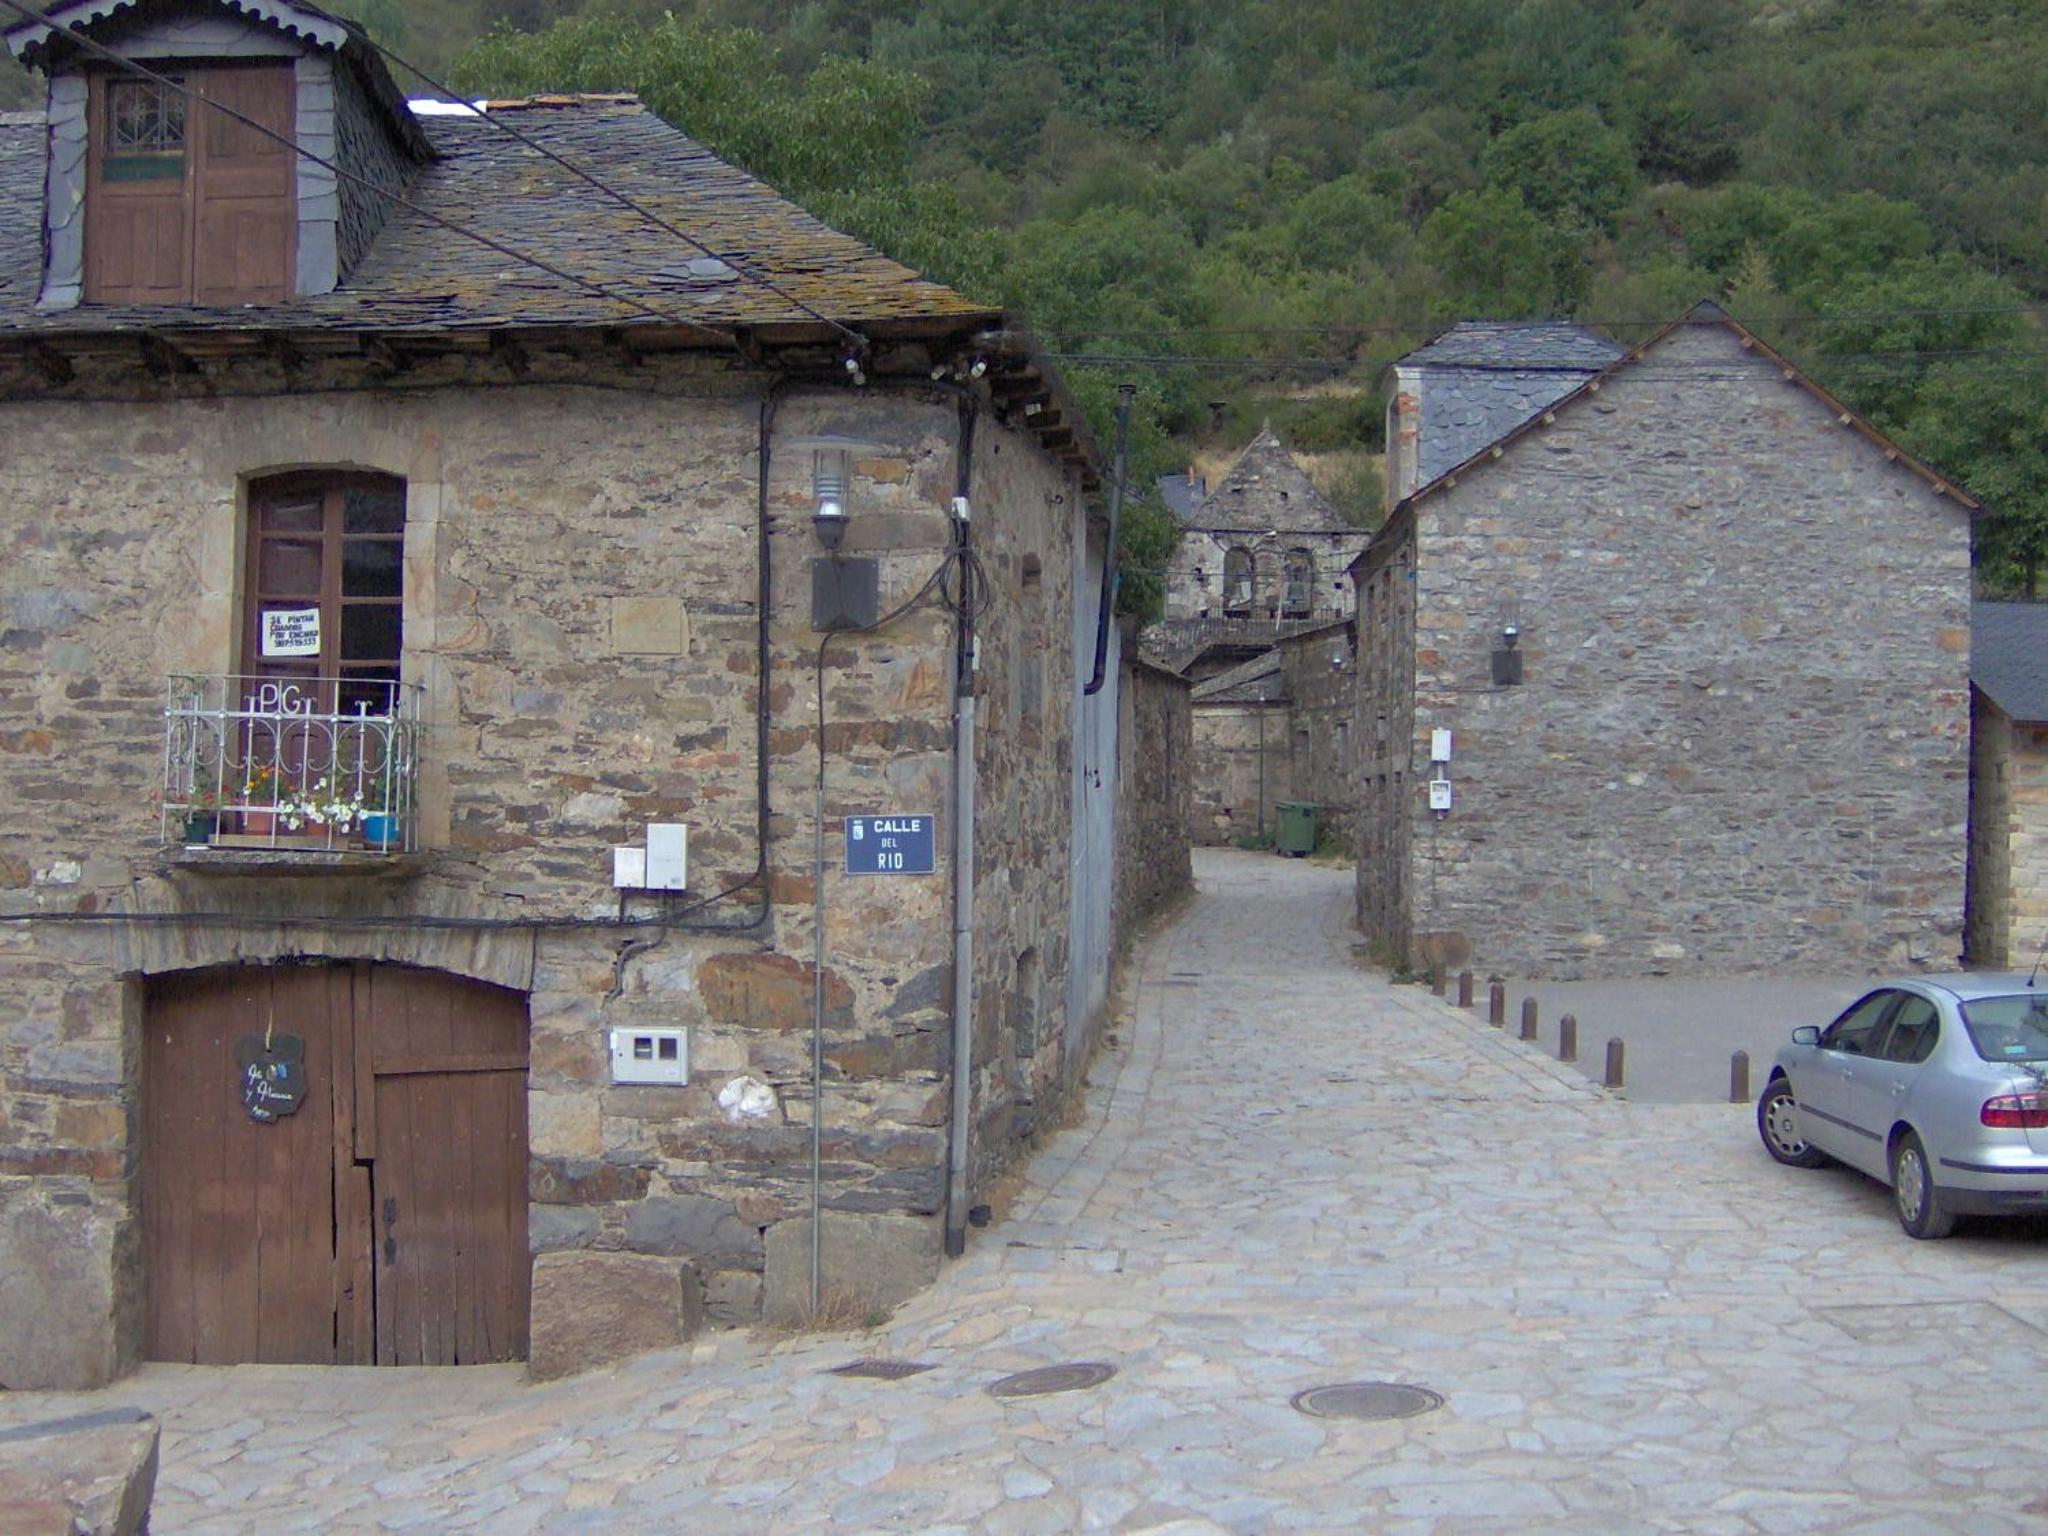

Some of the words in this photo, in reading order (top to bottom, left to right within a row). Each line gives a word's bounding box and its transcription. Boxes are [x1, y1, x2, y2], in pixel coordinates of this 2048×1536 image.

[288, 614, 315, 623] PINTAN
[874, 820, 921, 833] CALLE
[881, 837, 897, 848] DEL
[878, 852, 903, 870] RIO
